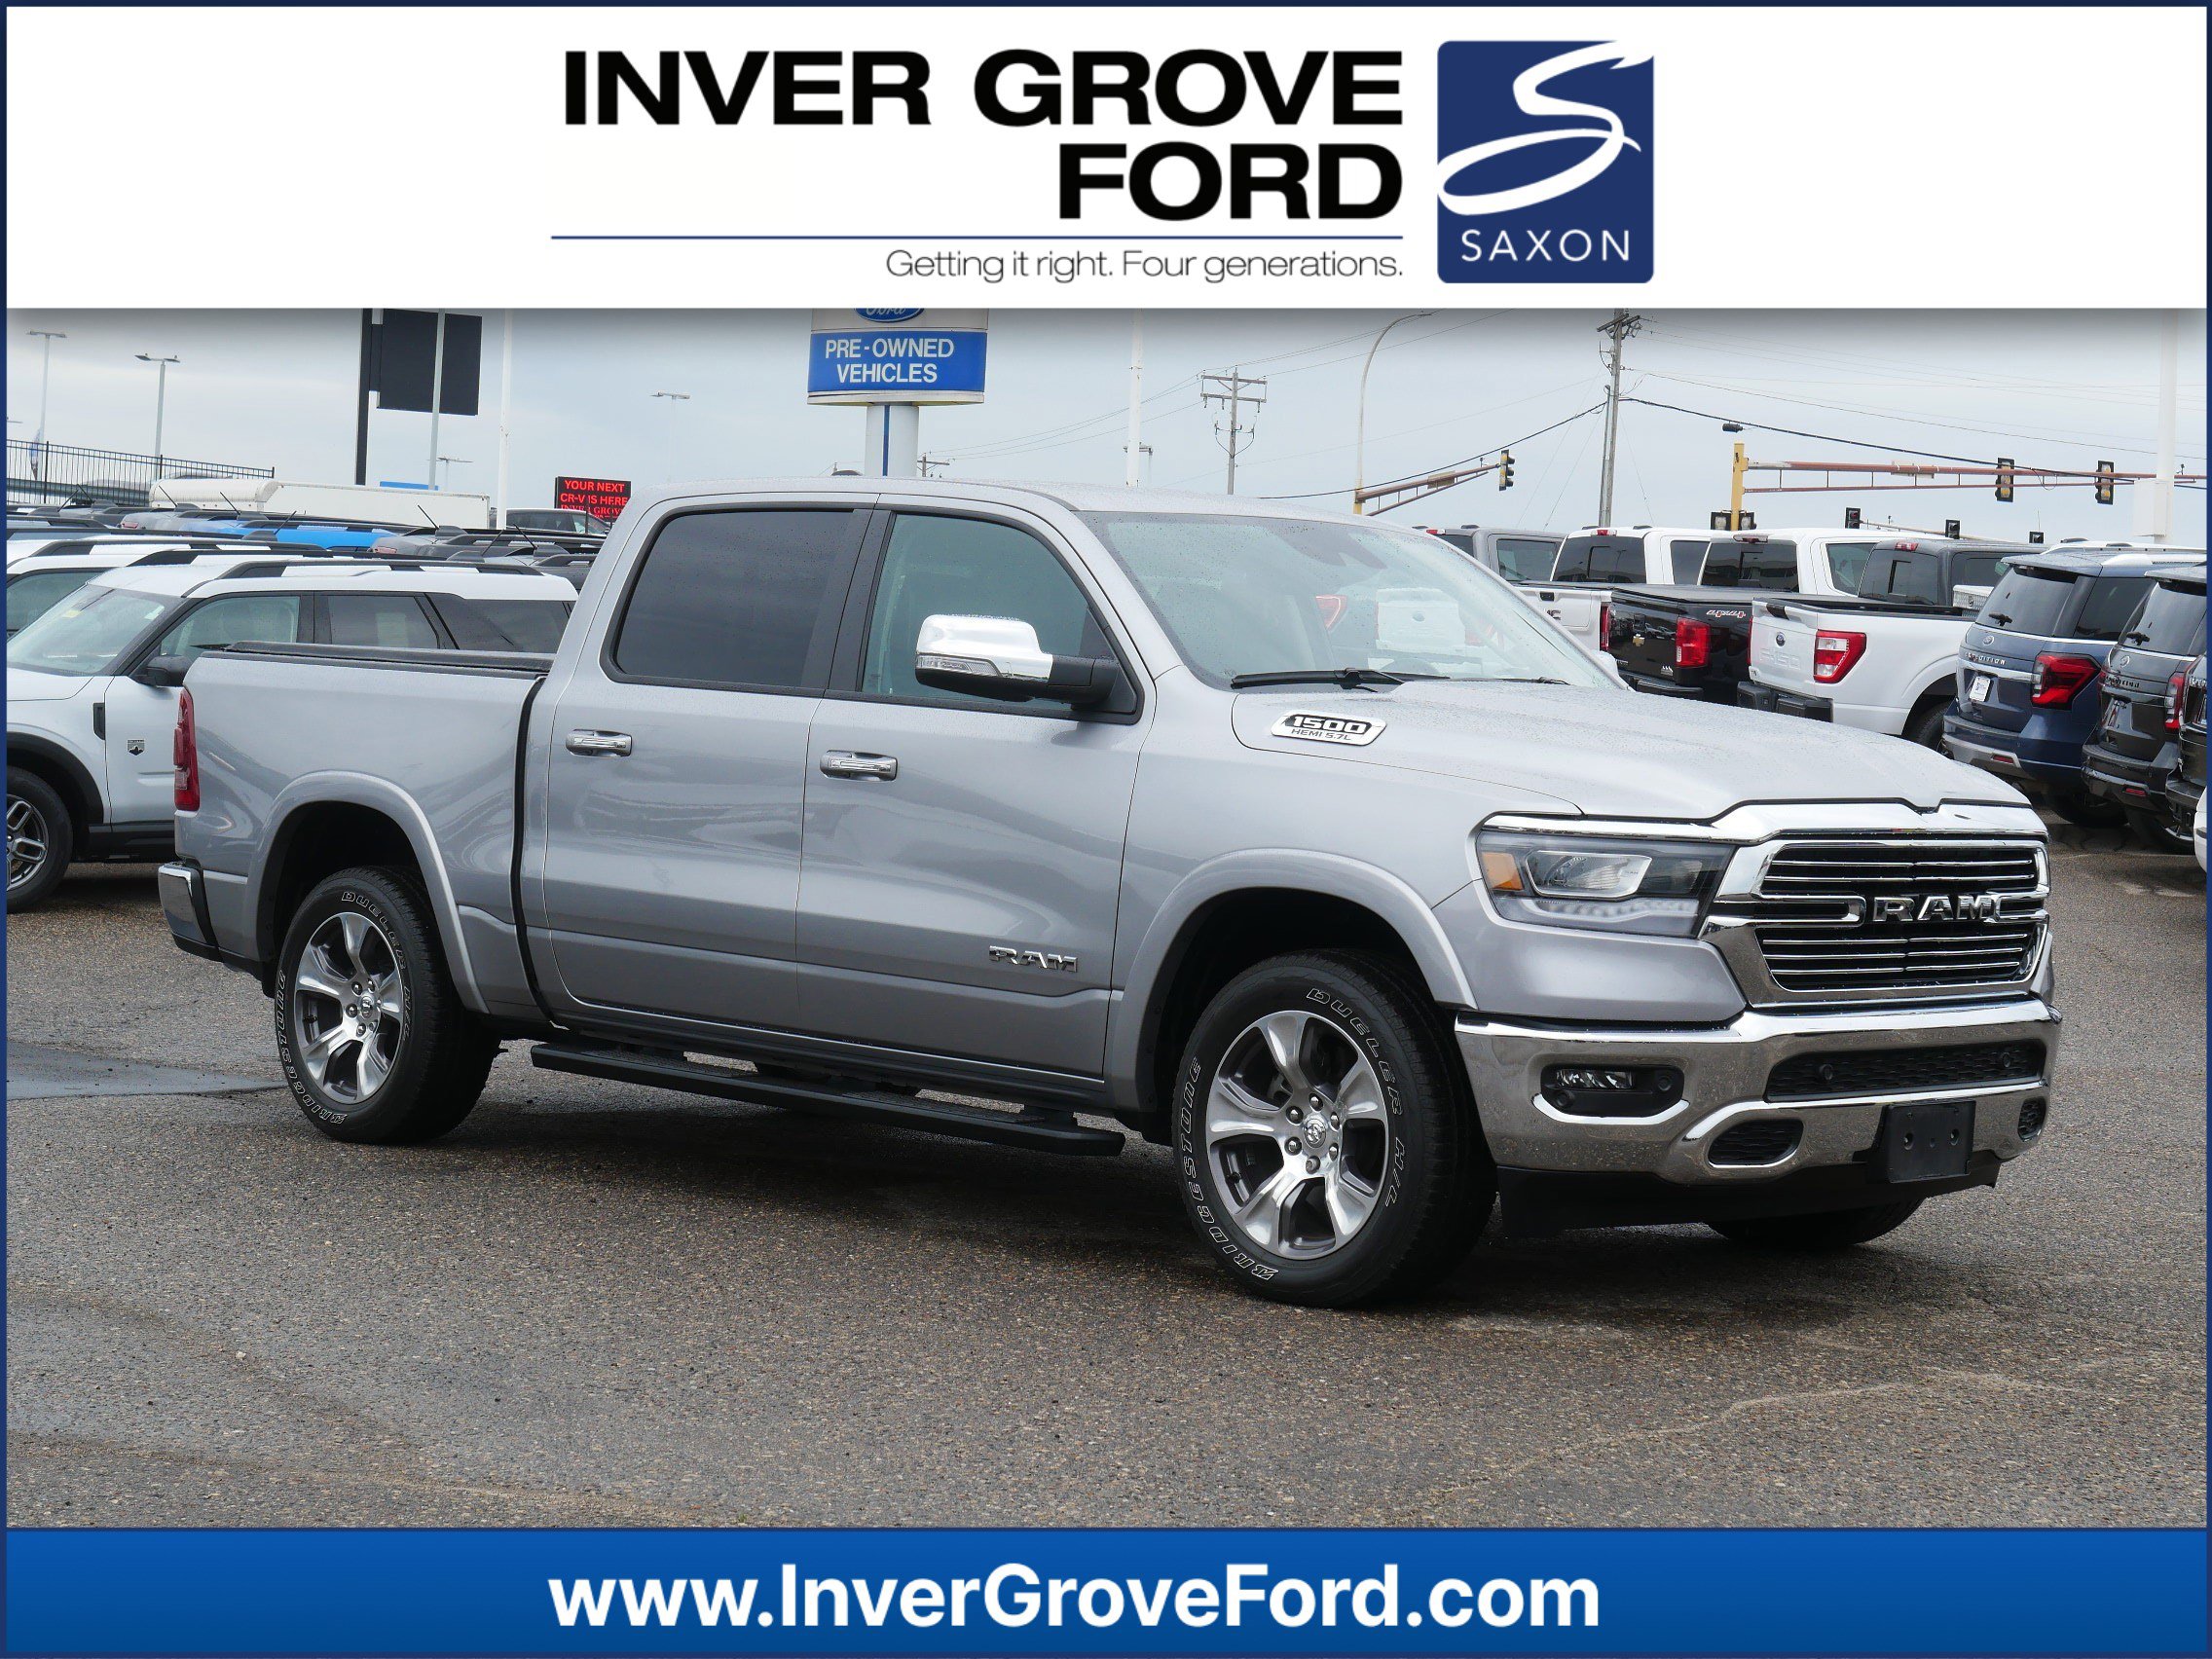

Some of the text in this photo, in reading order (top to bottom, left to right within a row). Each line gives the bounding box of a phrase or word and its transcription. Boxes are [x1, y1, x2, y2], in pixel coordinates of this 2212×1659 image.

[836, 363, 938, 383] VEHICLES
[560, 493, 629, 506] CR-V IS HERE
[565, 480, 625, 493] YOUR NEXT
[1291, 728, 1352, 741] HEMI 5.7L
[1293, 716, 1368, 734] 1500
[1873, 895, 1997, 922] RAM
[342, 892, 406, 971] DUELER
[989, 944, 1078, 973] RAM
[277, 970, 349, 1124] BRIDGESTONE
[1307, 988, 1404, 1116] DUELER
[1180, 1056, 1279, 1281] BRIDGESTONE
